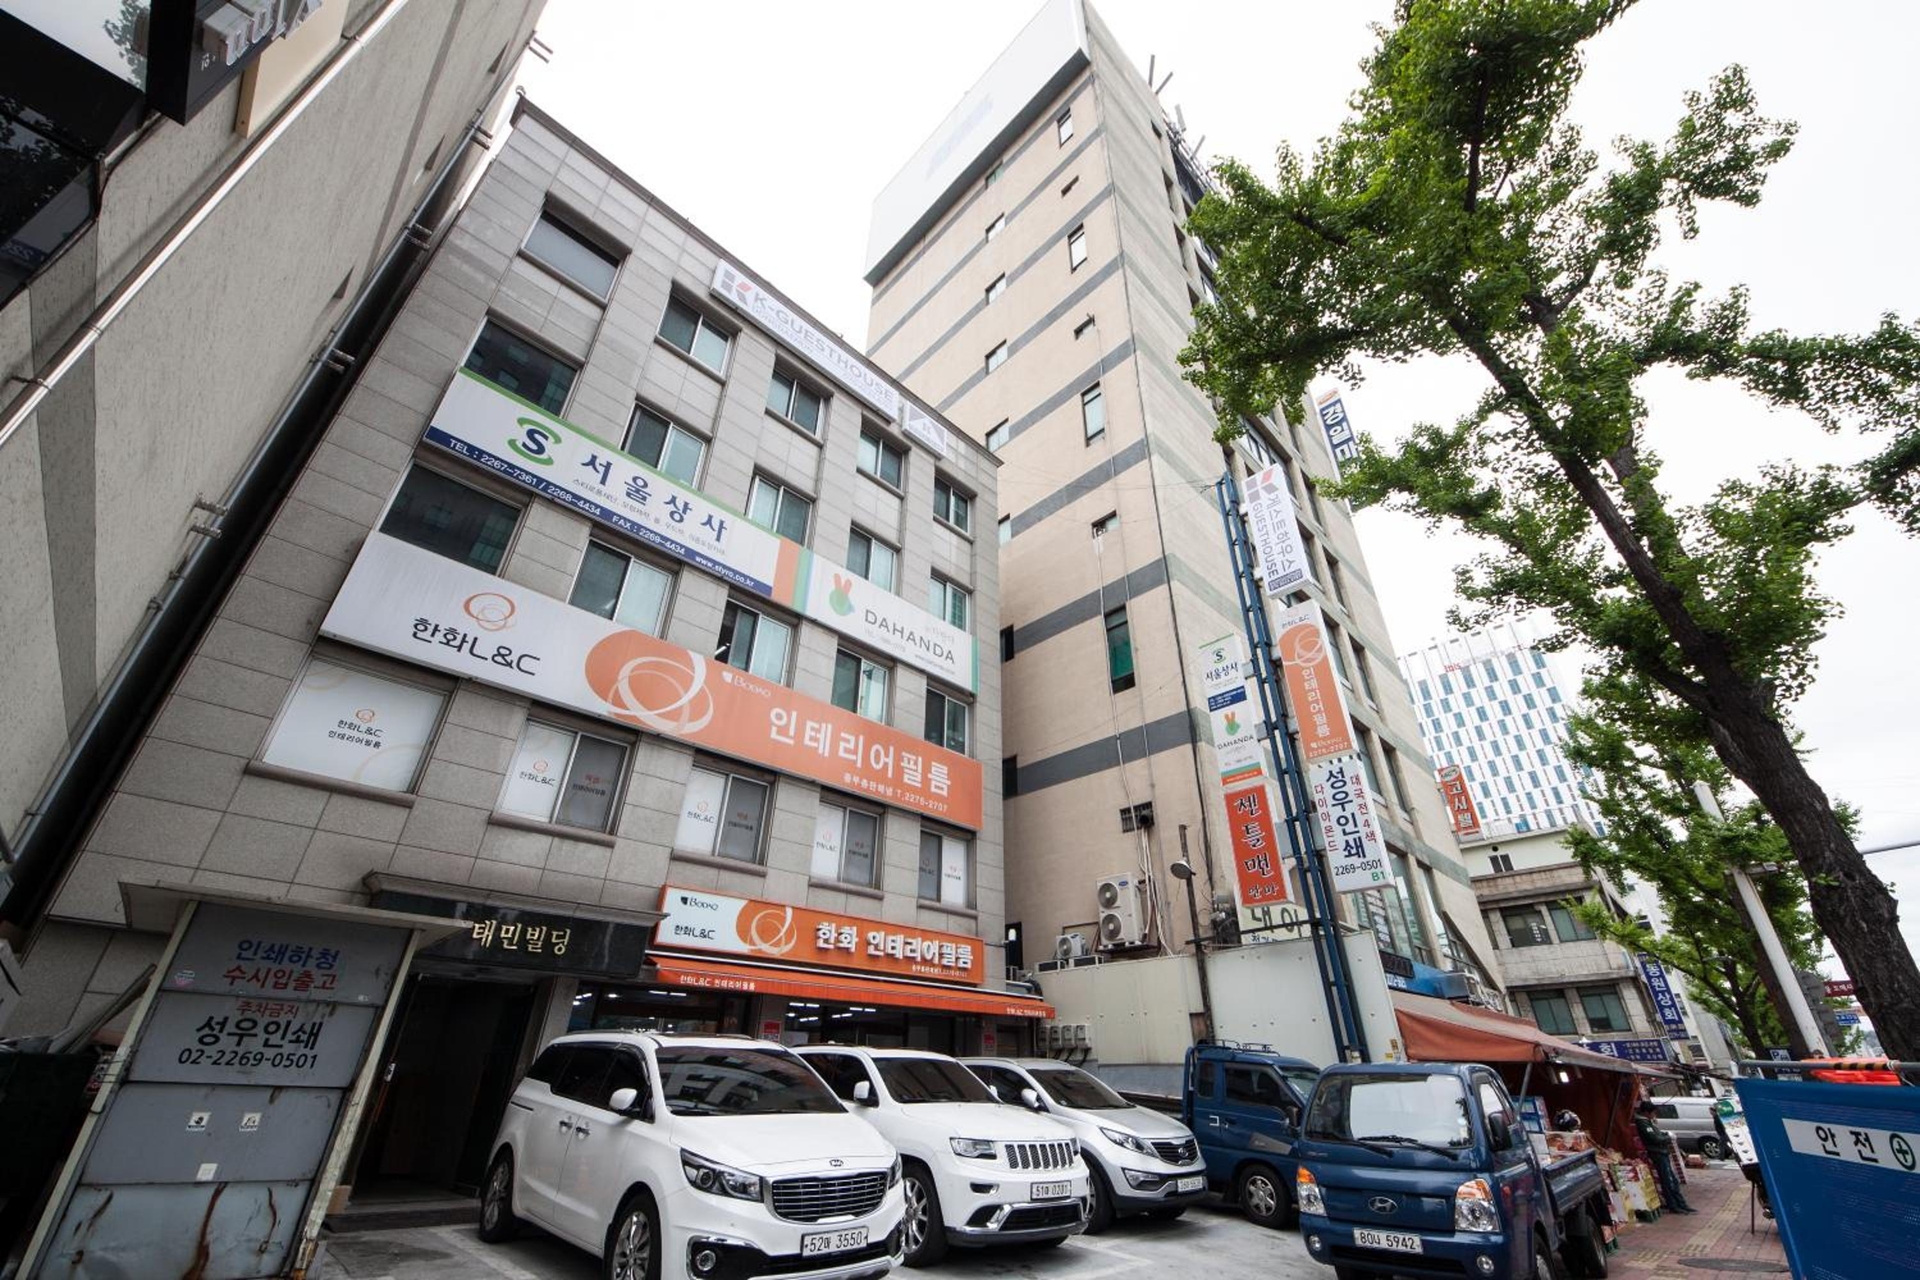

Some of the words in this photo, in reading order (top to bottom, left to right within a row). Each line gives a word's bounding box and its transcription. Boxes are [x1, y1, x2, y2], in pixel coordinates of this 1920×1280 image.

[754, 291, 894, 402] K-GUESTHOUSE
[450, 438, 469, 456] TEL
[481, 453, 537, 485] 2267-7361
[548, 485, 601, 515] 2268-4434
[611, 514, 631, 531] FAX
[695, 555, 755, 587] www.styro.co.kr
[581, 454, 727, 543] 서울상사
[1252, 502, 1279, 579] GUESTHOUSE
[412, 617, 540, 676] 한화L&C
[865, 609, 955, 664] DAHANDA
[770, 707, 950, 798] 인테리어필름
[1217, 735, 1254, 750] DAHANDA
[1314, 784, 1339, 852] 다이아몬드
[1326, 767, 1366, 859] 성우인쇄
[1234, 793, 1274, 877] 젠틀맨
[1334, 859, 1383, 876] 2269-0501
[1371, 871, 1386, 881] B1
[472, 919, 571, 955] 태민빌딩
[674, 925, 716, 940] 한화L&C
[815, 921, 858, 952] 한화
[866, 931, 974, 969] 인테리어필름
[236, 939, 340, 971] 인쇄하청
[222, 965, 338, 991] 수시입출고
[235, 1001, 299, 1018] 주차금지
[196, 1015, 324, 1050] 성우인쇄
[178, 1048, 318, 1070] 02-2269-0501
[836, 1231, 862, 1249] 3550
[1386, 1234, 1416, 1250] 5942
